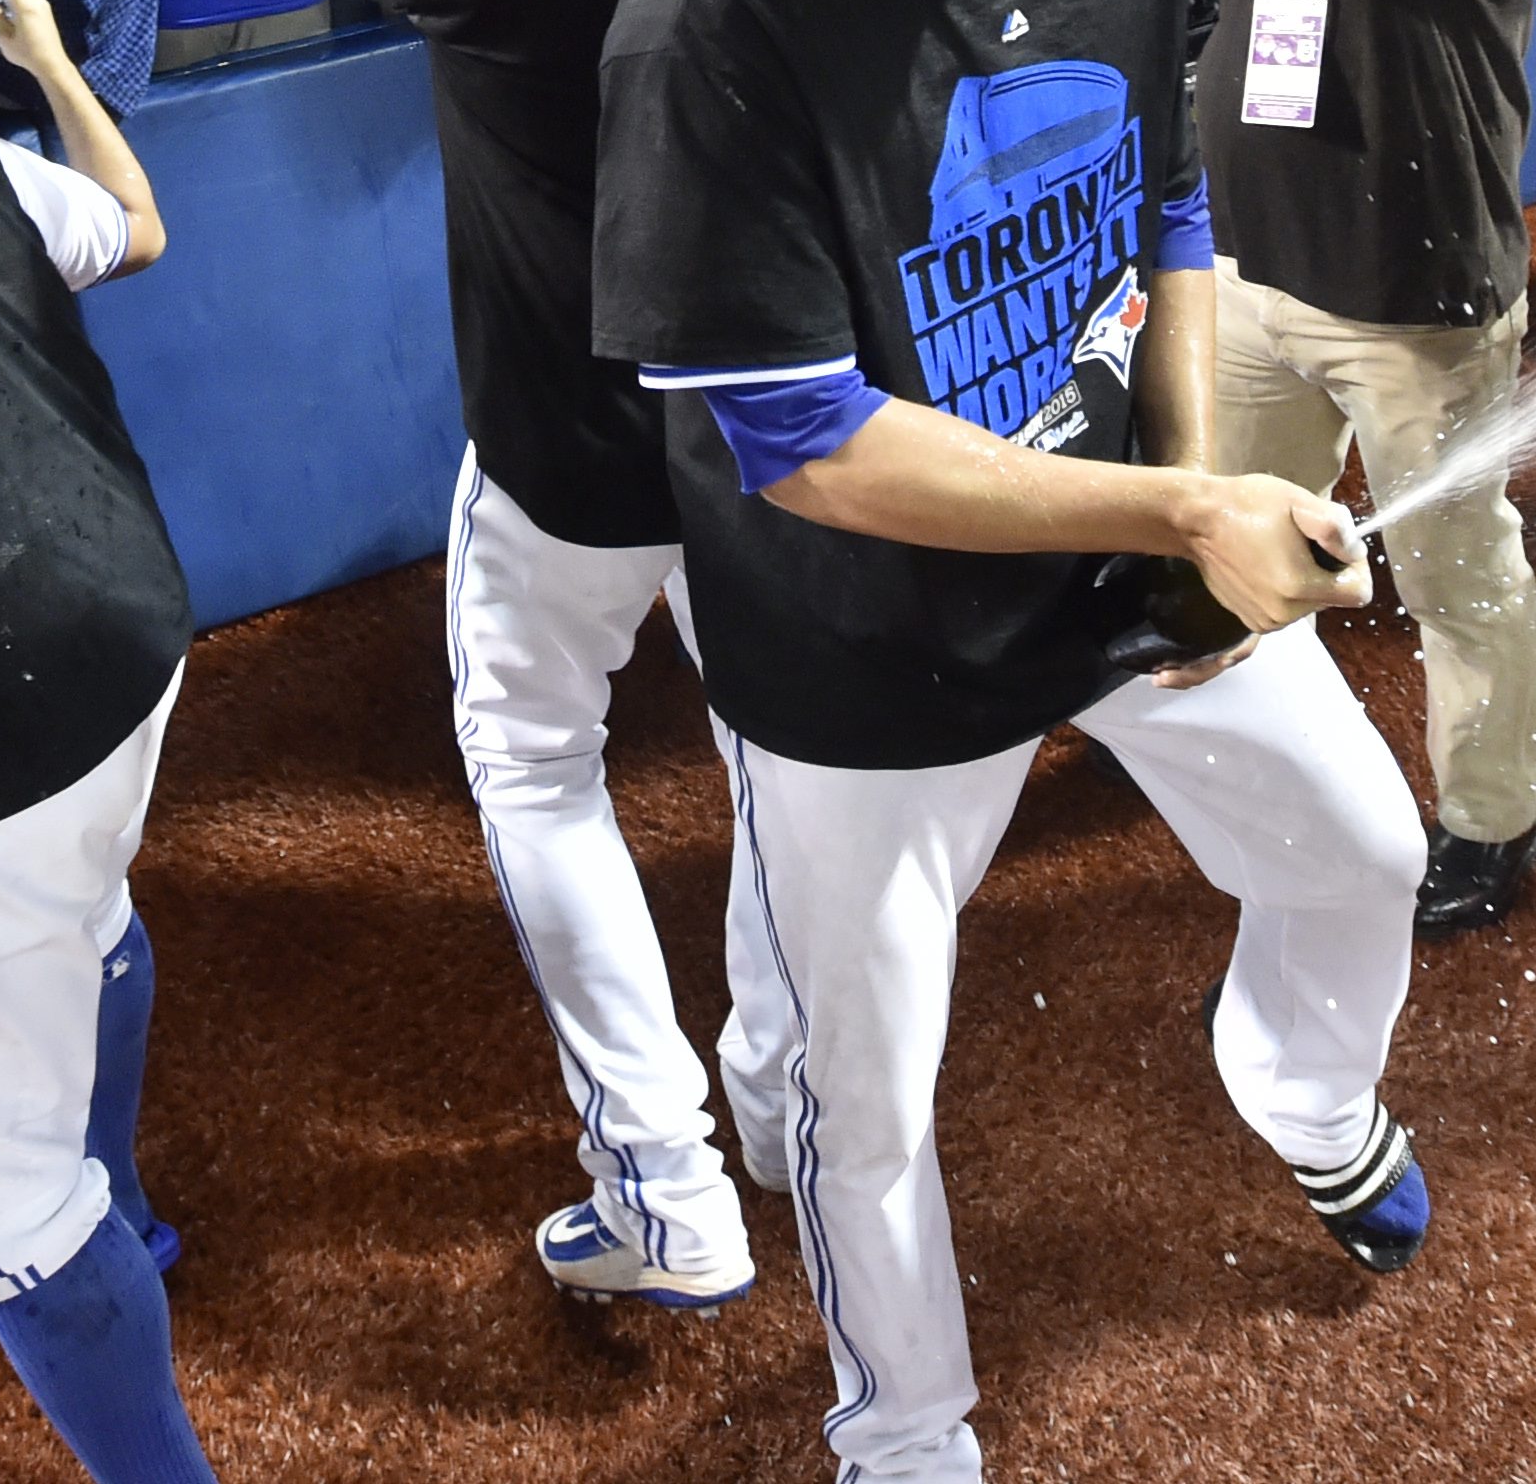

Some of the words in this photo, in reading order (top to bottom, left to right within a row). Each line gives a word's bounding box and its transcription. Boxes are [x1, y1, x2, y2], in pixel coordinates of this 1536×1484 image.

[905, 125, 1139, 323] TORONTO
[915, 240, 1096, 402] WANTS
[1097, 189, 1145, 280] IT
